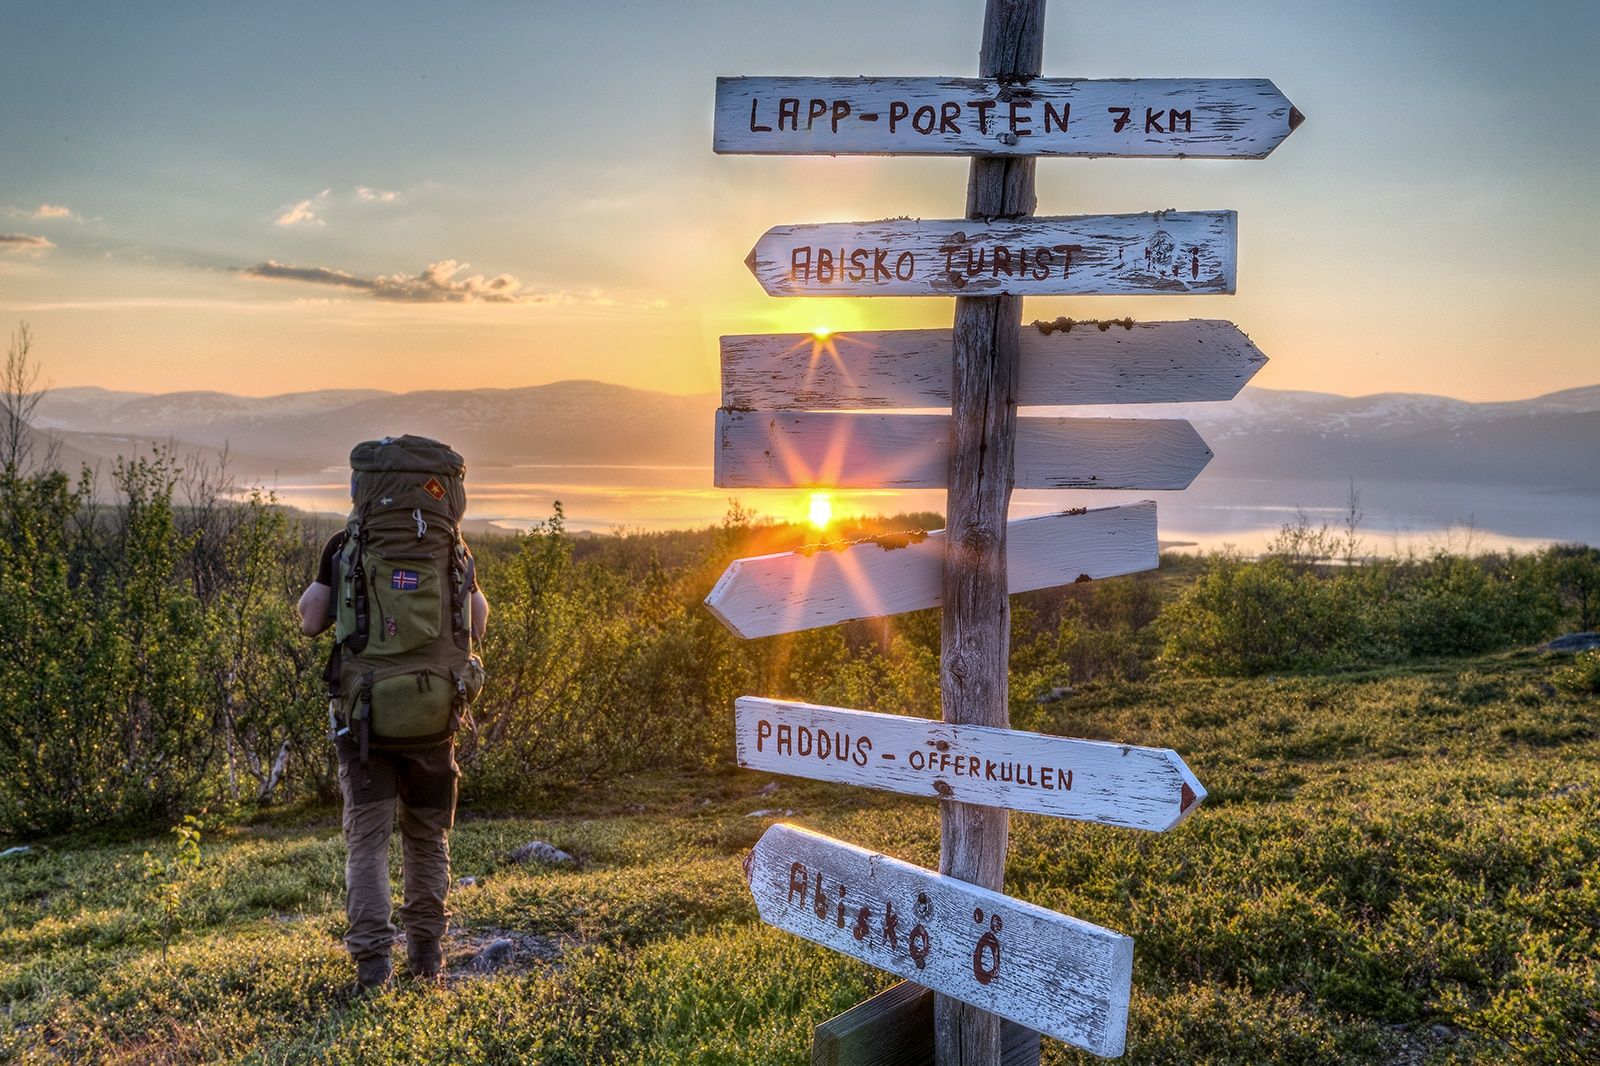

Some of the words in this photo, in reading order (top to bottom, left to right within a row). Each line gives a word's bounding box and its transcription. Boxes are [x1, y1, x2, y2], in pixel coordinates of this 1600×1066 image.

[750, 98, 1071, 135] LAPP-PORTEN
[1108, 105, 1130, 132] 7
[1145, 105, 1193, 133] KM
[791, 245, 914, 283] ABISKO
[939, 244, 1082, 281] TURIST
[756, 719, 873, 766] PADDUS
[908, 750, 1074, 792] OFFERKULLEN
[972, 907, 1003, 985] Ö
